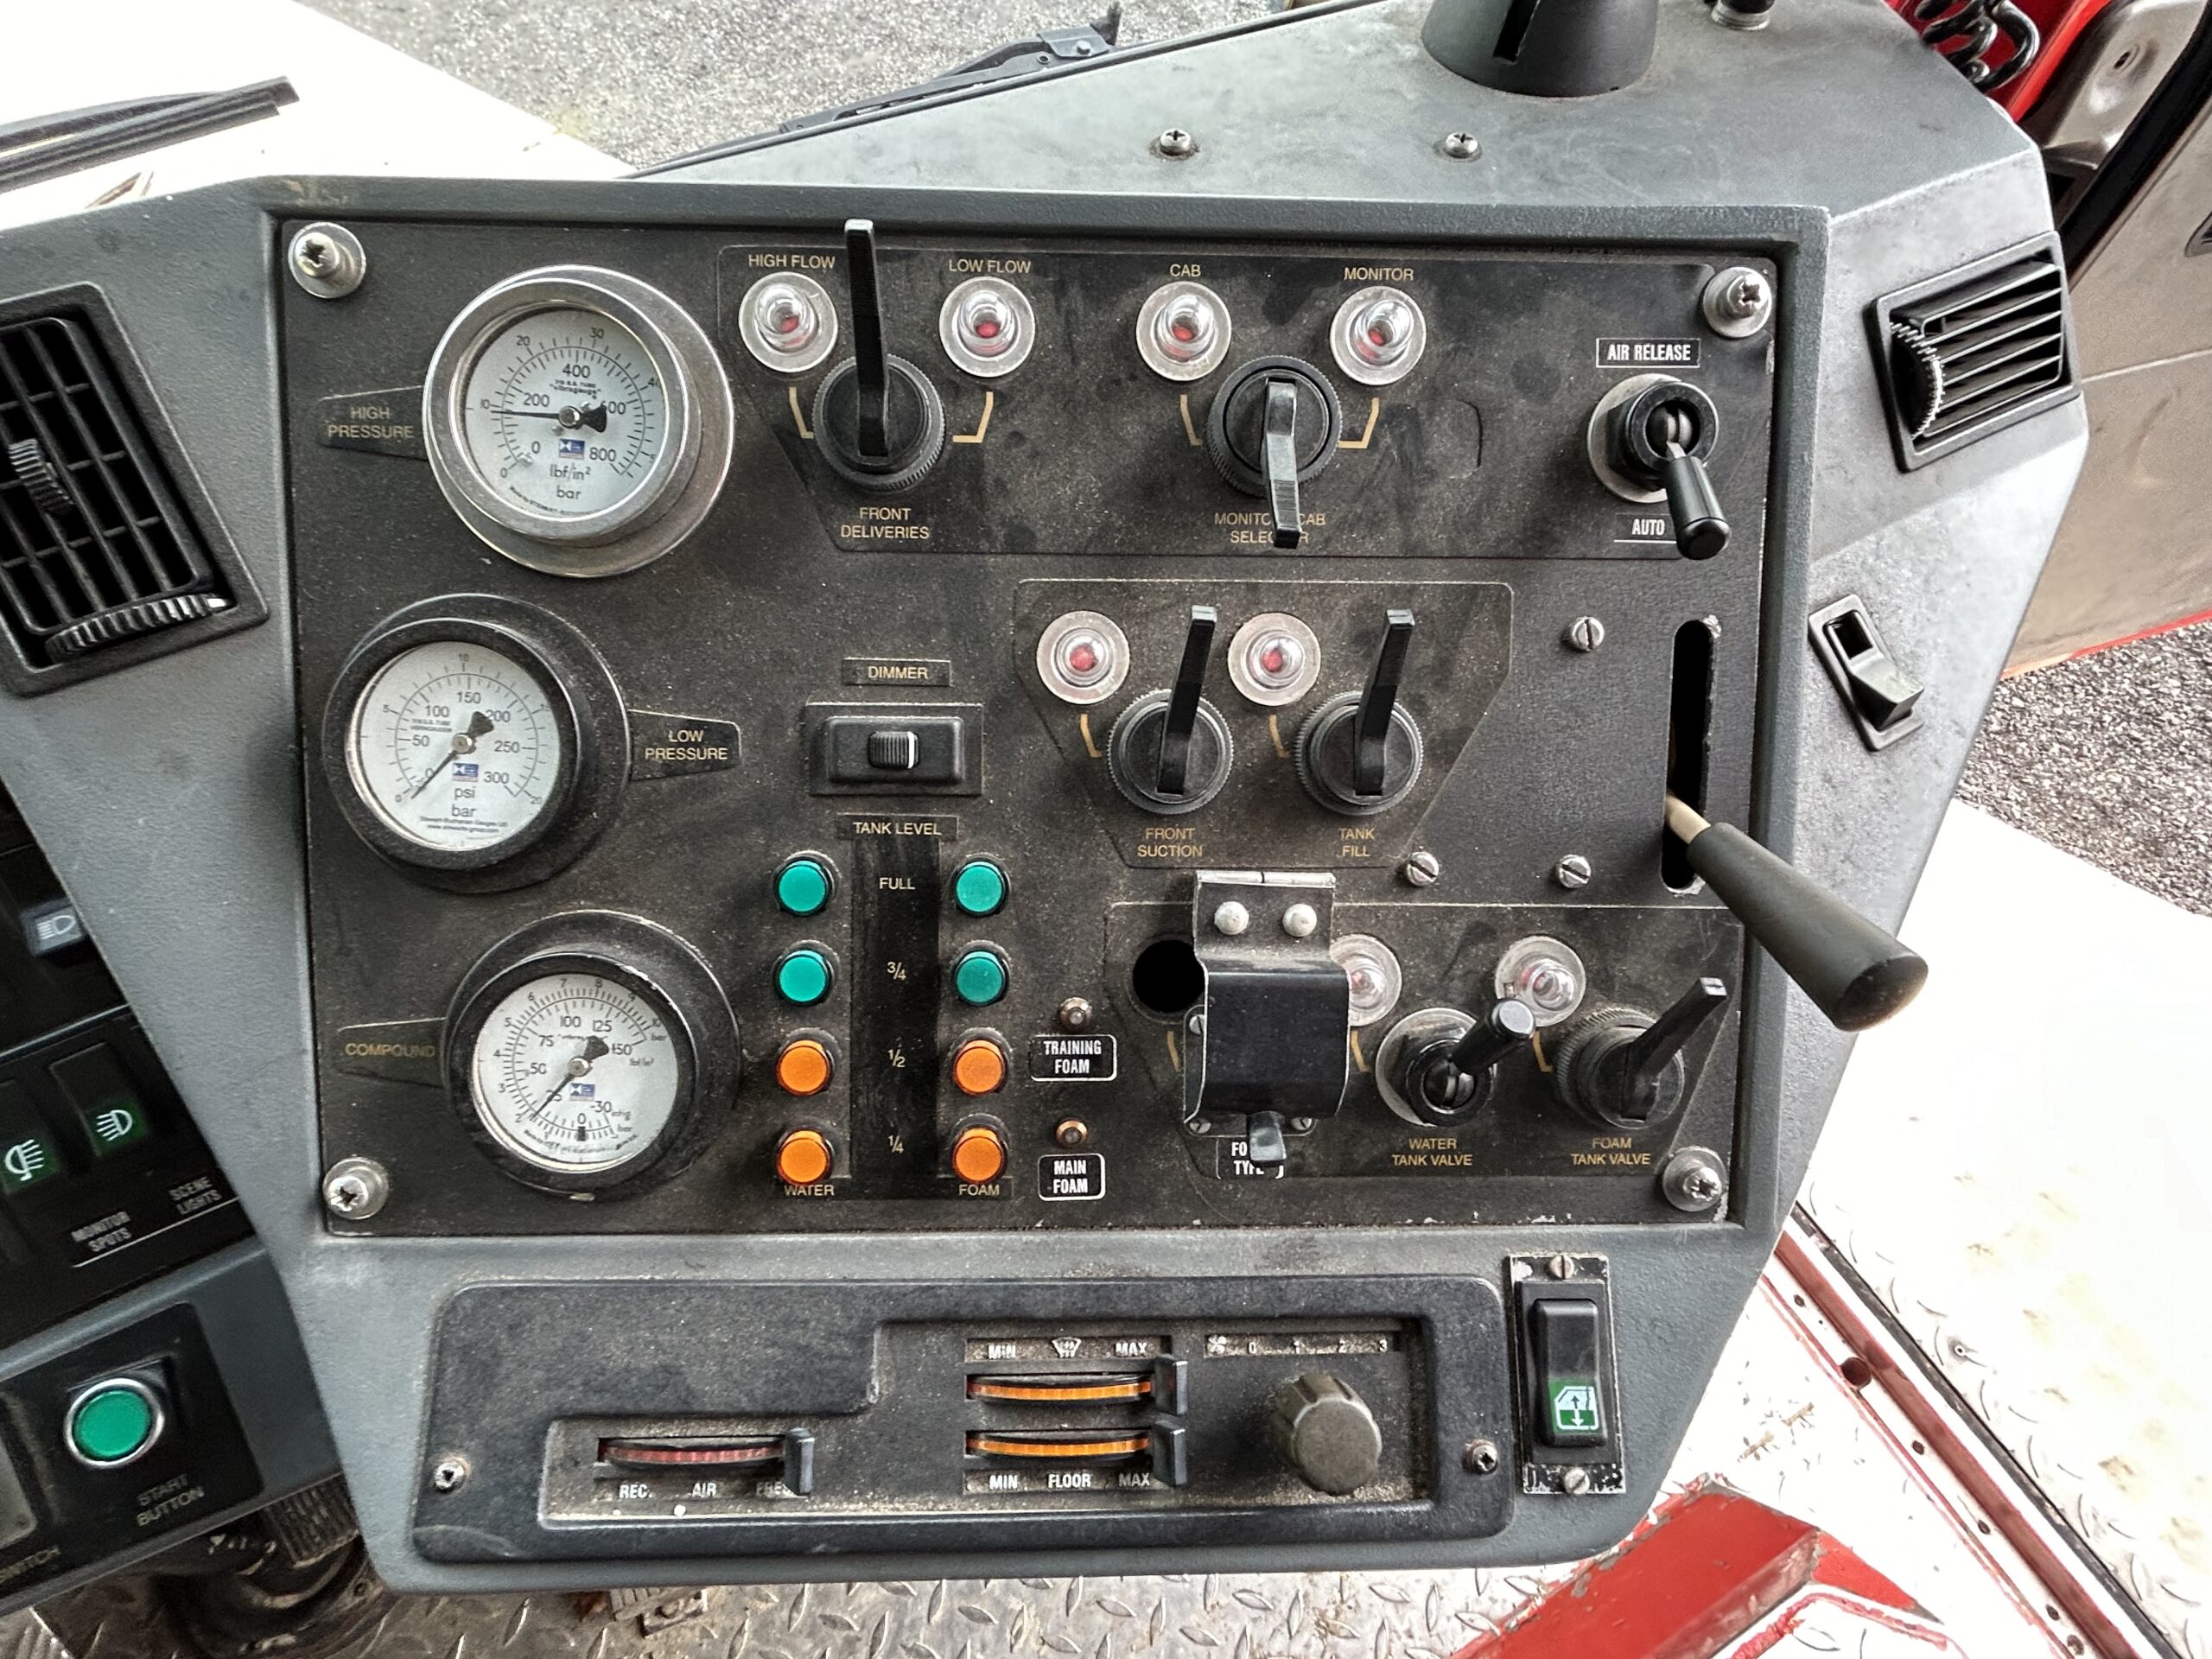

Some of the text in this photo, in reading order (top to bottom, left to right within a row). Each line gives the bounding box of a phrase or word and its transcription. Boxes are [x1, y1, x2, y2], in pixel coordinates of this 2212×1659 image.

[748, 254, 836, 270] HIGH FLOW
[949, 259, 1031, 274] LOW FLOW
[1170, 264, 1201, 277] CAB
[1344, 267, 1414, 282] MONITOR
[590, 326, 605, 340] 30
[516, 334, 531, 347] 20
[1607, 343, 1691, 361] AIR RELEASE
[562, 363, 591, 379] 400
[480, 398, 491, 410] 10
[523, 392, 550, 408] 200
[350, 405, 391, 420] HIGH
[328, 423, 415, 439] PRESSURE
[531, 441, 541, 454] 0
[589, 447, 617, 462] 800
[500, 467, 508, 479] 0
[556, 485, 582, 500] bar
[859, 506, 912, 521] FRONT
[1214, 512, 1271, 526] MONITO
[840, 524, 931, 540] DELIVERIES
[1631, 518, 1666, 537] AUTO
[458, 652, 470, 663] 10
[868, 666, 929, 679] DIMMER
[456, 691, 482, 704] 150
[382, 703, 390, 714] 5
[424, 704, 450, 718] 100
[485, 709, 512, 722] 200
[411, 734, 430, 747] 50
[668, 729, 703, 743] LOW
[493, 740, 520, 753] 250
[645, 747, 728, 761] PRESSURE
[425, 767, 434, 779] 0
[483, 771, 510, 784] 300
[395, 793, 402, 803] 0
[454, 785, 476, 800] psi
[531, 795, 543, 805] 20
[451, 804, 477, 817] bar
[853, 821, 943, 836] TANK LEVEL
[1145, 827, 1195, 841] FRONT
[1339, 828, 1376, 841] TANK
[1137, 844, 1203, 858] SUCTION
[1342, 844, 1371, 857] FILL
[880, 877, 916, 891] FULL
[559, 978, 567, 988] 7
[595, 977, 603, 988] 8
[528, 991, 535, 1001] 6
[628, 992, 636, 1002] 9
[504, 1017, 512, 1027] 5
[560, 1015, 582, 1027] 100
[592, 1020, 613, 1033] 125
[538, 1034, 555, 1047] 75
[345, 1042, 436, 1058] COMPOUND
[493, 1049, 501, 1058] 4
[612, 1043, 632, 1056] 150
[1043, 1040, 1102, 1056] TRAINING
[530, 1062, 547, 1075] 50
[1054, 1058, 1090, 1074] FOAM
[498, 1083, 506, 1093] 3
[589, 1100, 613, 1113] -30
[515, 1113, 522, 1123] 2
[577, 1112, 587, 1125] 0
[1408, 1138, 1458, 1151] WATER
[1592, 1137, 1632, 1150] FOAM
[1392, 1154, 1473, 1167] TANK VALVE
[1571, 1153, 1651, 1166] TANK VALVE
[1053, 1160, 1087, 1176] MAIN
[784, 1184, 835, 1197] WATER
[958, 1184, 1001, 1197] FOAM
[1052, 1178, 1089, 1194] FOAM
[88, 1227, 132, 1253] SPOTS
[988, 1342, 1147, 1360] MIN MAX
[1248, 1341, 1256, 1355] 0
[1338, 1339, 1348, 1354] 2
[1379, 1338, 1388, 1353] 3
[988, 1471, 1151, 1491] MIN FLOOR MAX
[137, 1471, 188, 1507] START
[692, 1482, 717, 1497] AIR
[136, 1486, 206, 1528] BUTTON
